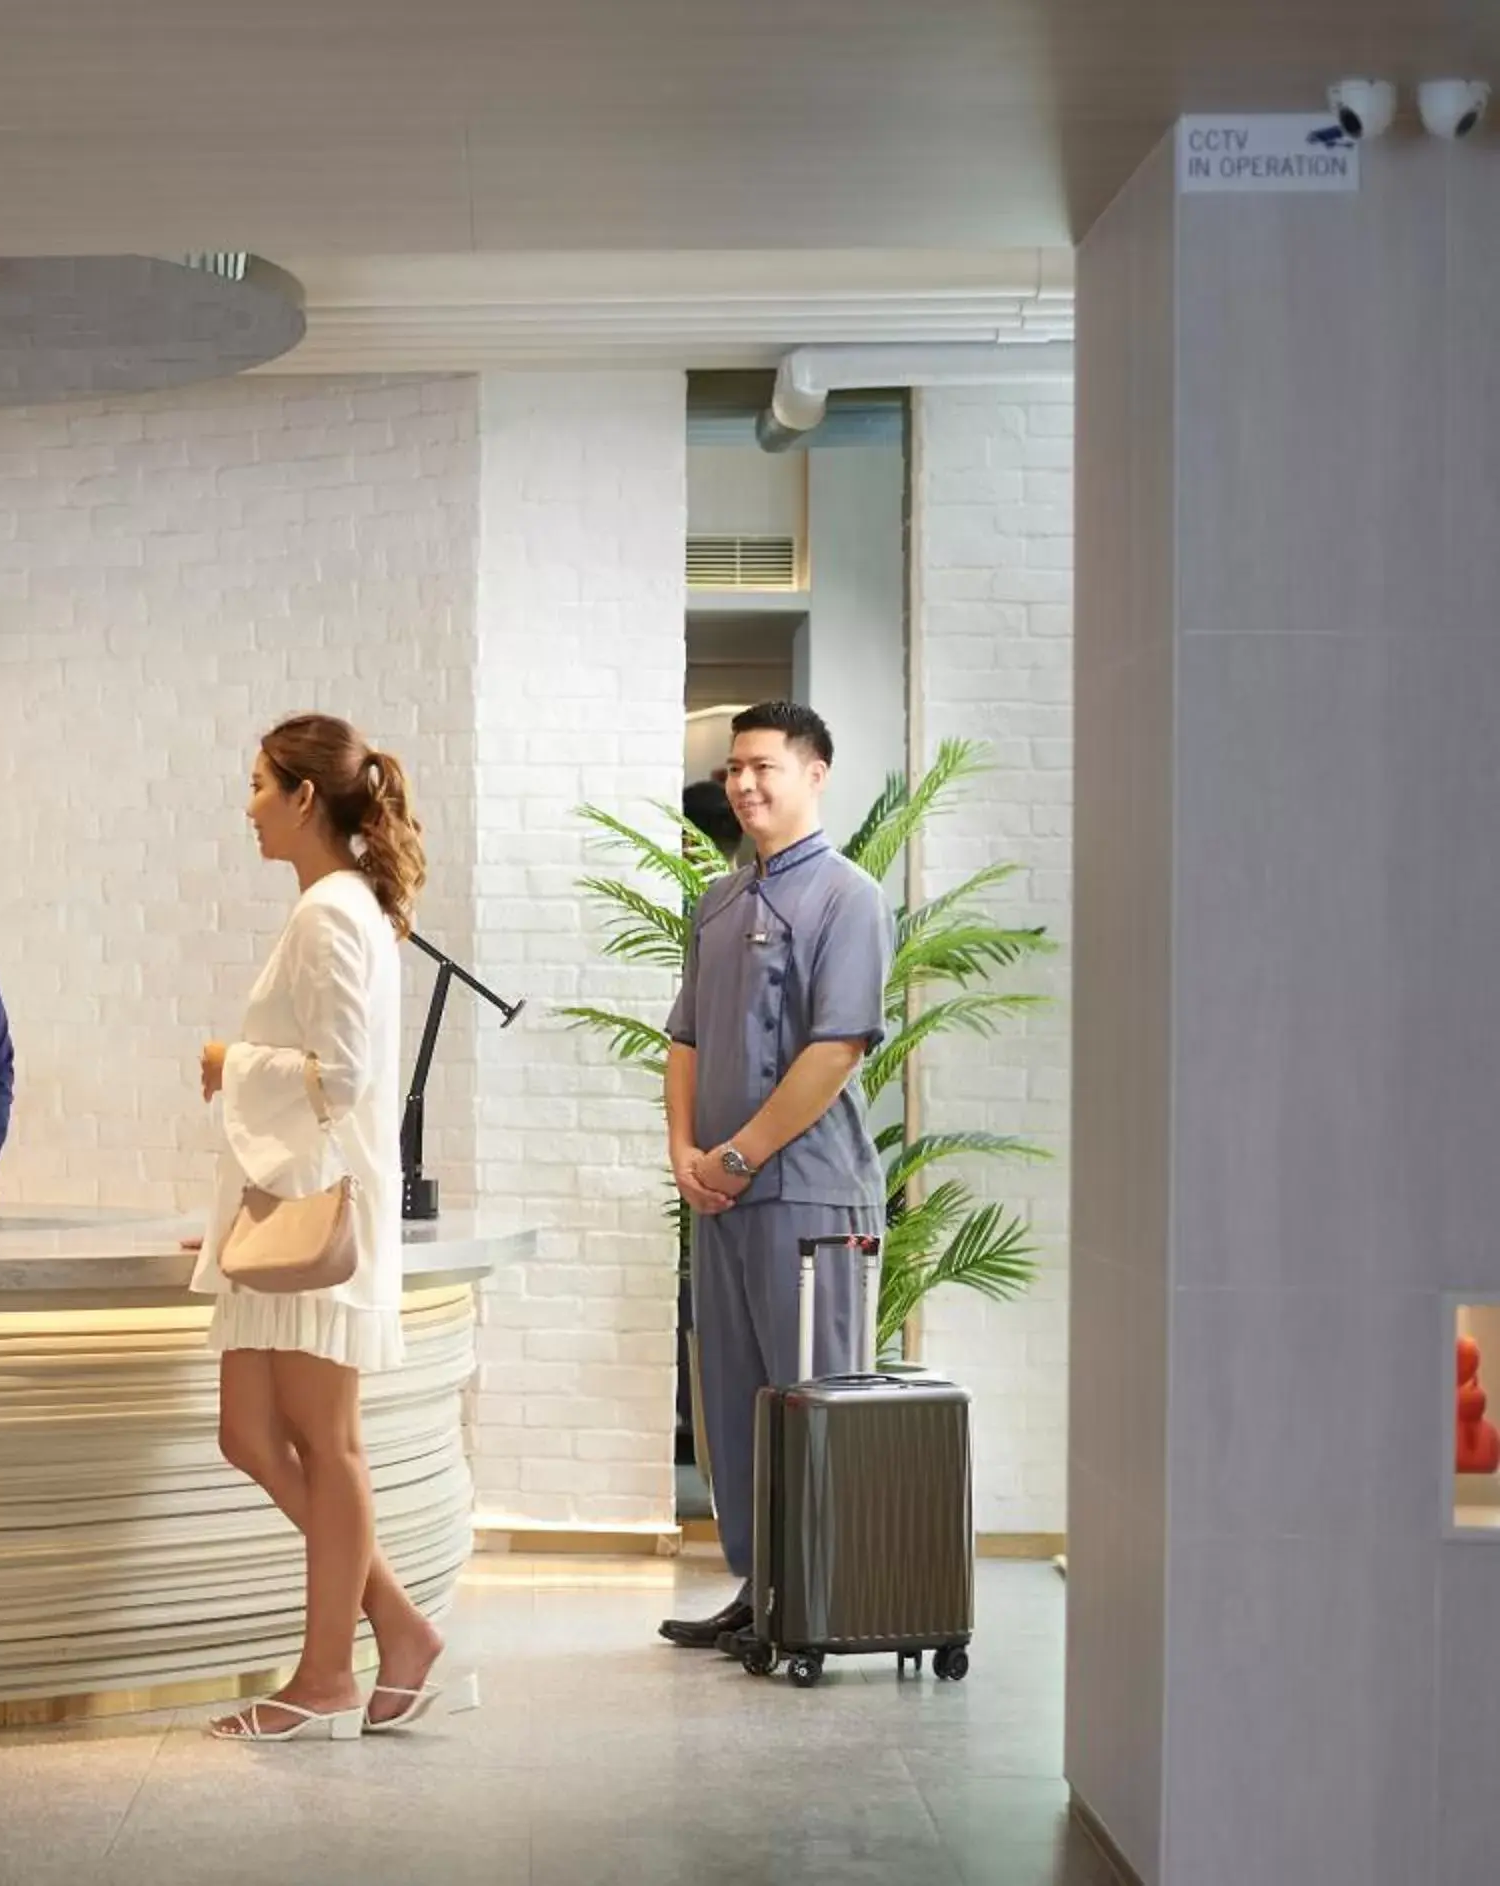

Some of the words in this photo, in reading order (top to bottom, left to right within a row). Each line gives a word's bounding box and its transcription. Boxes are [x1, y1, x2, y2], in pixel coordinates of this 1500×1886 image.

[1188, 129, 1248, 151] CCTV
[1188, 156, 1210, 177] IN
[1219, 154, 1347, 177] OPERATION
